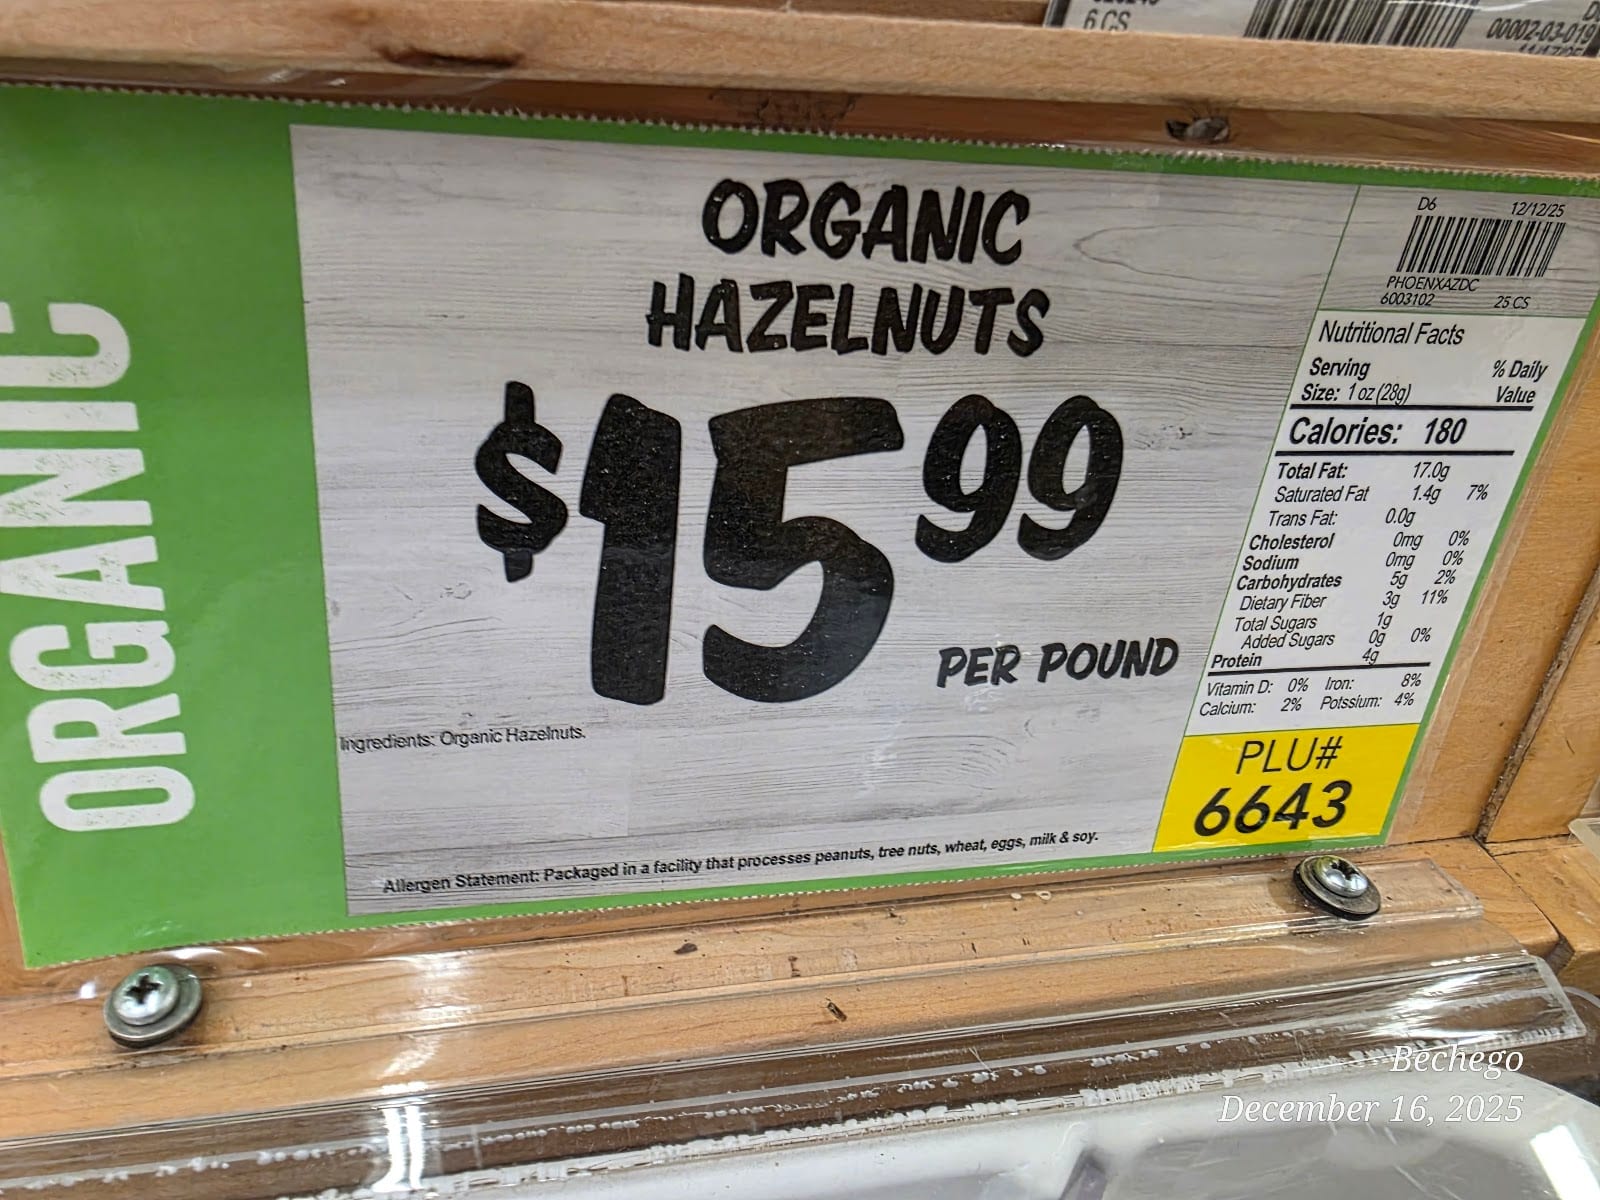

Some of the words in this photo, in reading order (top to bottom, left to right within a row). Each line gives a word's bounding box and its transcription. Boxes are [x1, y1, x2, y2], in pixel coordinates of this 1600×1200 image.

[1100, 9, 1131, 31] CS
[1418, 197, 1438, 211] D6
[1511, 202, 1566, 218] 12/12/25
[701, 178, 1030, 266] ORGANIC
[1386, 276, 1480, 292] PHOENXAZDC
[1380, 293, 1436, 307] 6003102
[1494, 296, 1511, 309] 25
[1512, 296, 1532, 309] CS
[645, 273, 1050, 357] HAZELNUTS
[1318, 319, 1413, 345] Nutritional
[1414, 322, 1465, 346] Facts
[1309, 356, 1371, 381] Serving
[1492, 359, 1505, 378] %
[1508, 360, 1549, 383] Daily
[1301, 383, 1341, 402] Size:
[1348, 384, 1355, 401] 1
[1357, 387, 1375, 401] oz
[1376, 383, 1412, 406] (28g)
[1496, 386, 1536, 404] Value
[1290, 417, 1403, 445] Calories:
[1424, 418, 1467, 445] 180
[1277, 462, 1315, 480] Total
[1317, 462, 1348, 479] Fat:
[1413, 461, 1450, 481] 17.0g
[1274, 485, 1342, 503] Saturated
[1344, 485, 1370, 502] Fat
[1412, 484, 1441, 504] 1.4g
[1466, 484, 1488, 501] 7%
[1268, 510, 1306, 527] Trans
[1309, 509, 1338, 526] Fat:
[1385, 507, 1416, 527] 0.0g
[1249, 533, 1335, 551] Cholesterol
[1393, 532, 1424, 551] 0mg
[1448, 530, 1470, 547] 0%
[0, 303, 195, 832] ORGANIC
[1242, 555, 1299, 572] Sodium
[1385, 552, 1416, 572] 0mg
[1442, 550, 1463, 567] 0%
[1236, 574, 1343, 592] Carbohydrates
[1389, 571, 1408, 589] 5g
[1434, 569, 1456, 586] 2%
[1239, 595, 1289, 613] Dietary
[1290, 594, 1327, 610] Fiber
[1382, 590, 1400, 608] 3g
[1420, 589, 1448, 606] 11%
[1234, 615, 1267, 632] Total
[1269, 614, 1317, 634] Sugars
[1377, 612, 1392, 629] 1g
[1241, 634, 1287, 650] Added
[1288, 632, 1335, 650] Sugars
[1368, 629, 1386, 646] 0g
[1410, 627, 1431, 643] 0%
[937, 647, 1018, 688] PER
[1038, 637, 1178, 682] POUND
[1210, 652, 1263, 669] Protein
[1362, 649, 1379, 665] 4g
[1206, 679, 1254, 697] Vitamin
[1256, 679, 1273, 695] D:
[1287, 677, 1309, 693] 0%
[1325, 676, 1354, 692] Iron:
[1400, 673, 1422, 688] 8%
[1199, 702, 1256, 717] Calcium:
[1280, 698, 1302, 713] 2%
[1319, 694, 1382, 711] Potssium:
[1394, 692, 1414, 707] 4%
[340, 734, 435, 753] Ingredients:
[440, 728, 501, 748] Organic
[505, 725, 585, 743] Hazelnuts.
[1235, 736, 1343, 775] PLU#
[1194, 779, 1352, 837] 6643
[383, 878, 451, 894] Allergen
[455, 871, 540, 888] Statement:
[544, 862, 618, 882] Packaged
[623, 862, 637, 876] in
[641, 863, 650, 875] a
[653, 857, 702, 875] facility
[706, 854, 734, 870] that
[738, 850, 812, 870] processes
[815, 847, 875, 866] peanuts,
[879, 845, 905, 858] tree
[908, 842, 942, 857] nuts,
[945, 838, 988, 853] wheat,
[991, 834, 1026, 851] eggs,
[1030, 831, 1057, 847] milk
[1060, 831, 1070, 844] &
[1073, 828, 1099, 845] soy.
